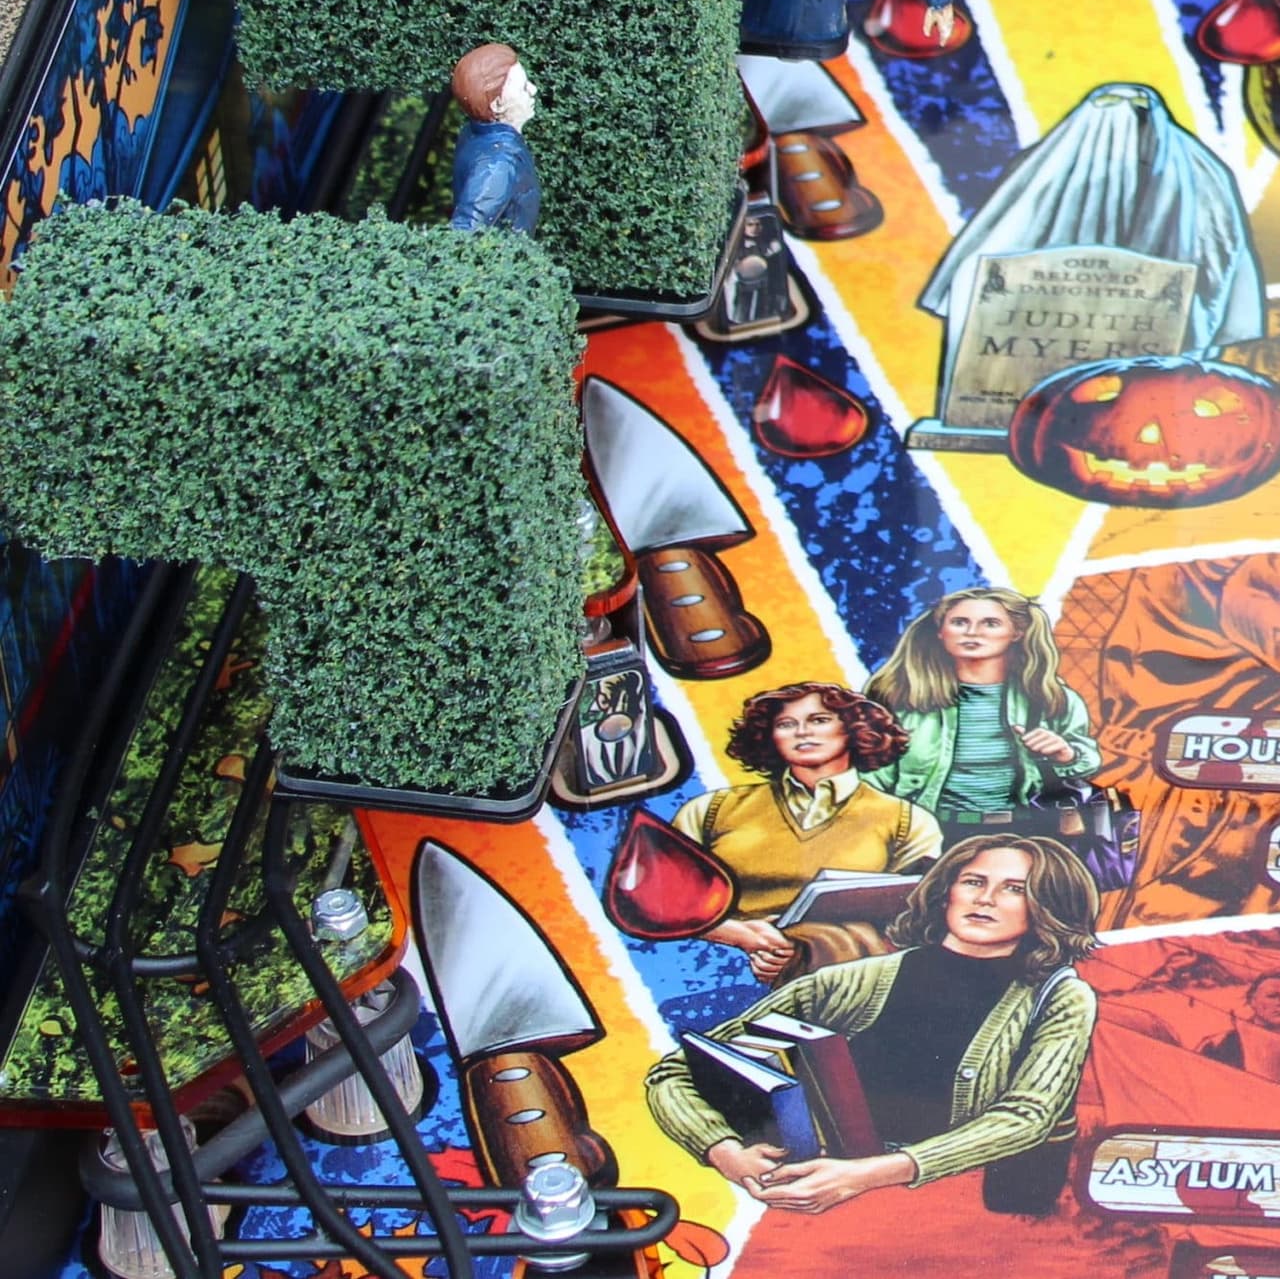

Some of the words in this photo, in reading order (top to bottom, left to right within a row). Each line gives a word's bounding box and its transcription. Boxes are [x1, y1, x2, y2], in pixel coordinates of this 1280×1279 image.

[1063, 257, 1110, 270] OUR
[1032, 270, 1140, 285] BELOVED
[1019, 283, 1149, 299] DAUGHTER
[995, 309, 1157, 333] JUDITH
[978, 335, 1162, 361] MYERS
[1101, 1157, 1279, 1194] ASYLUM
